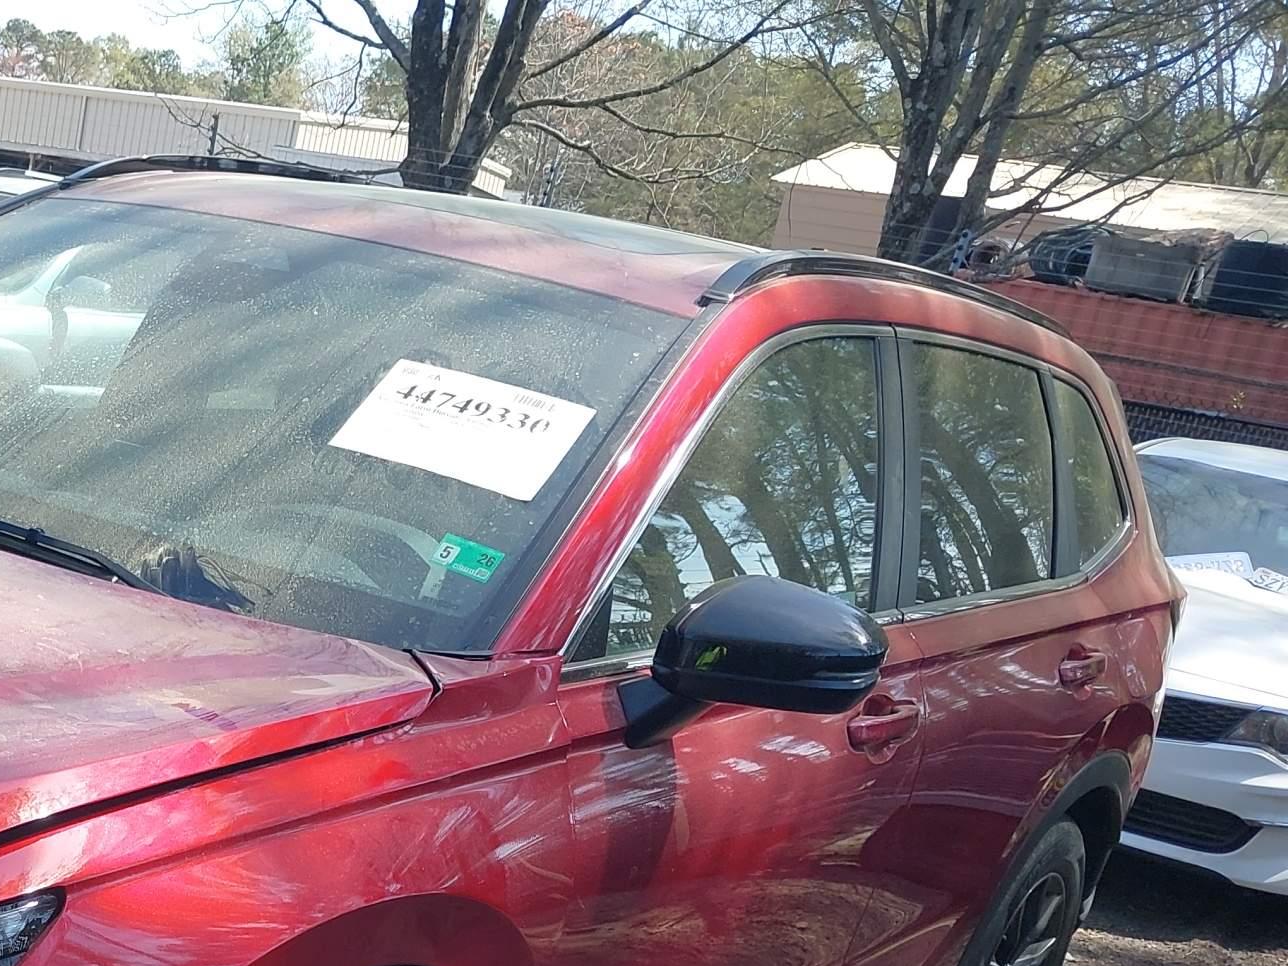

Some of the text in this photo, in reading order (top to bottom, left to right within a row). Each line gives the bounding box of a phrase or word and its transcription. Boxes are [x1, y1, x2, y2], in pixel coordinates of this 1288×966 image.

[396, 384, 551, 433] 44749330
[439, 544, 454, 560] 5
[476, 553, 497, 568] 26
